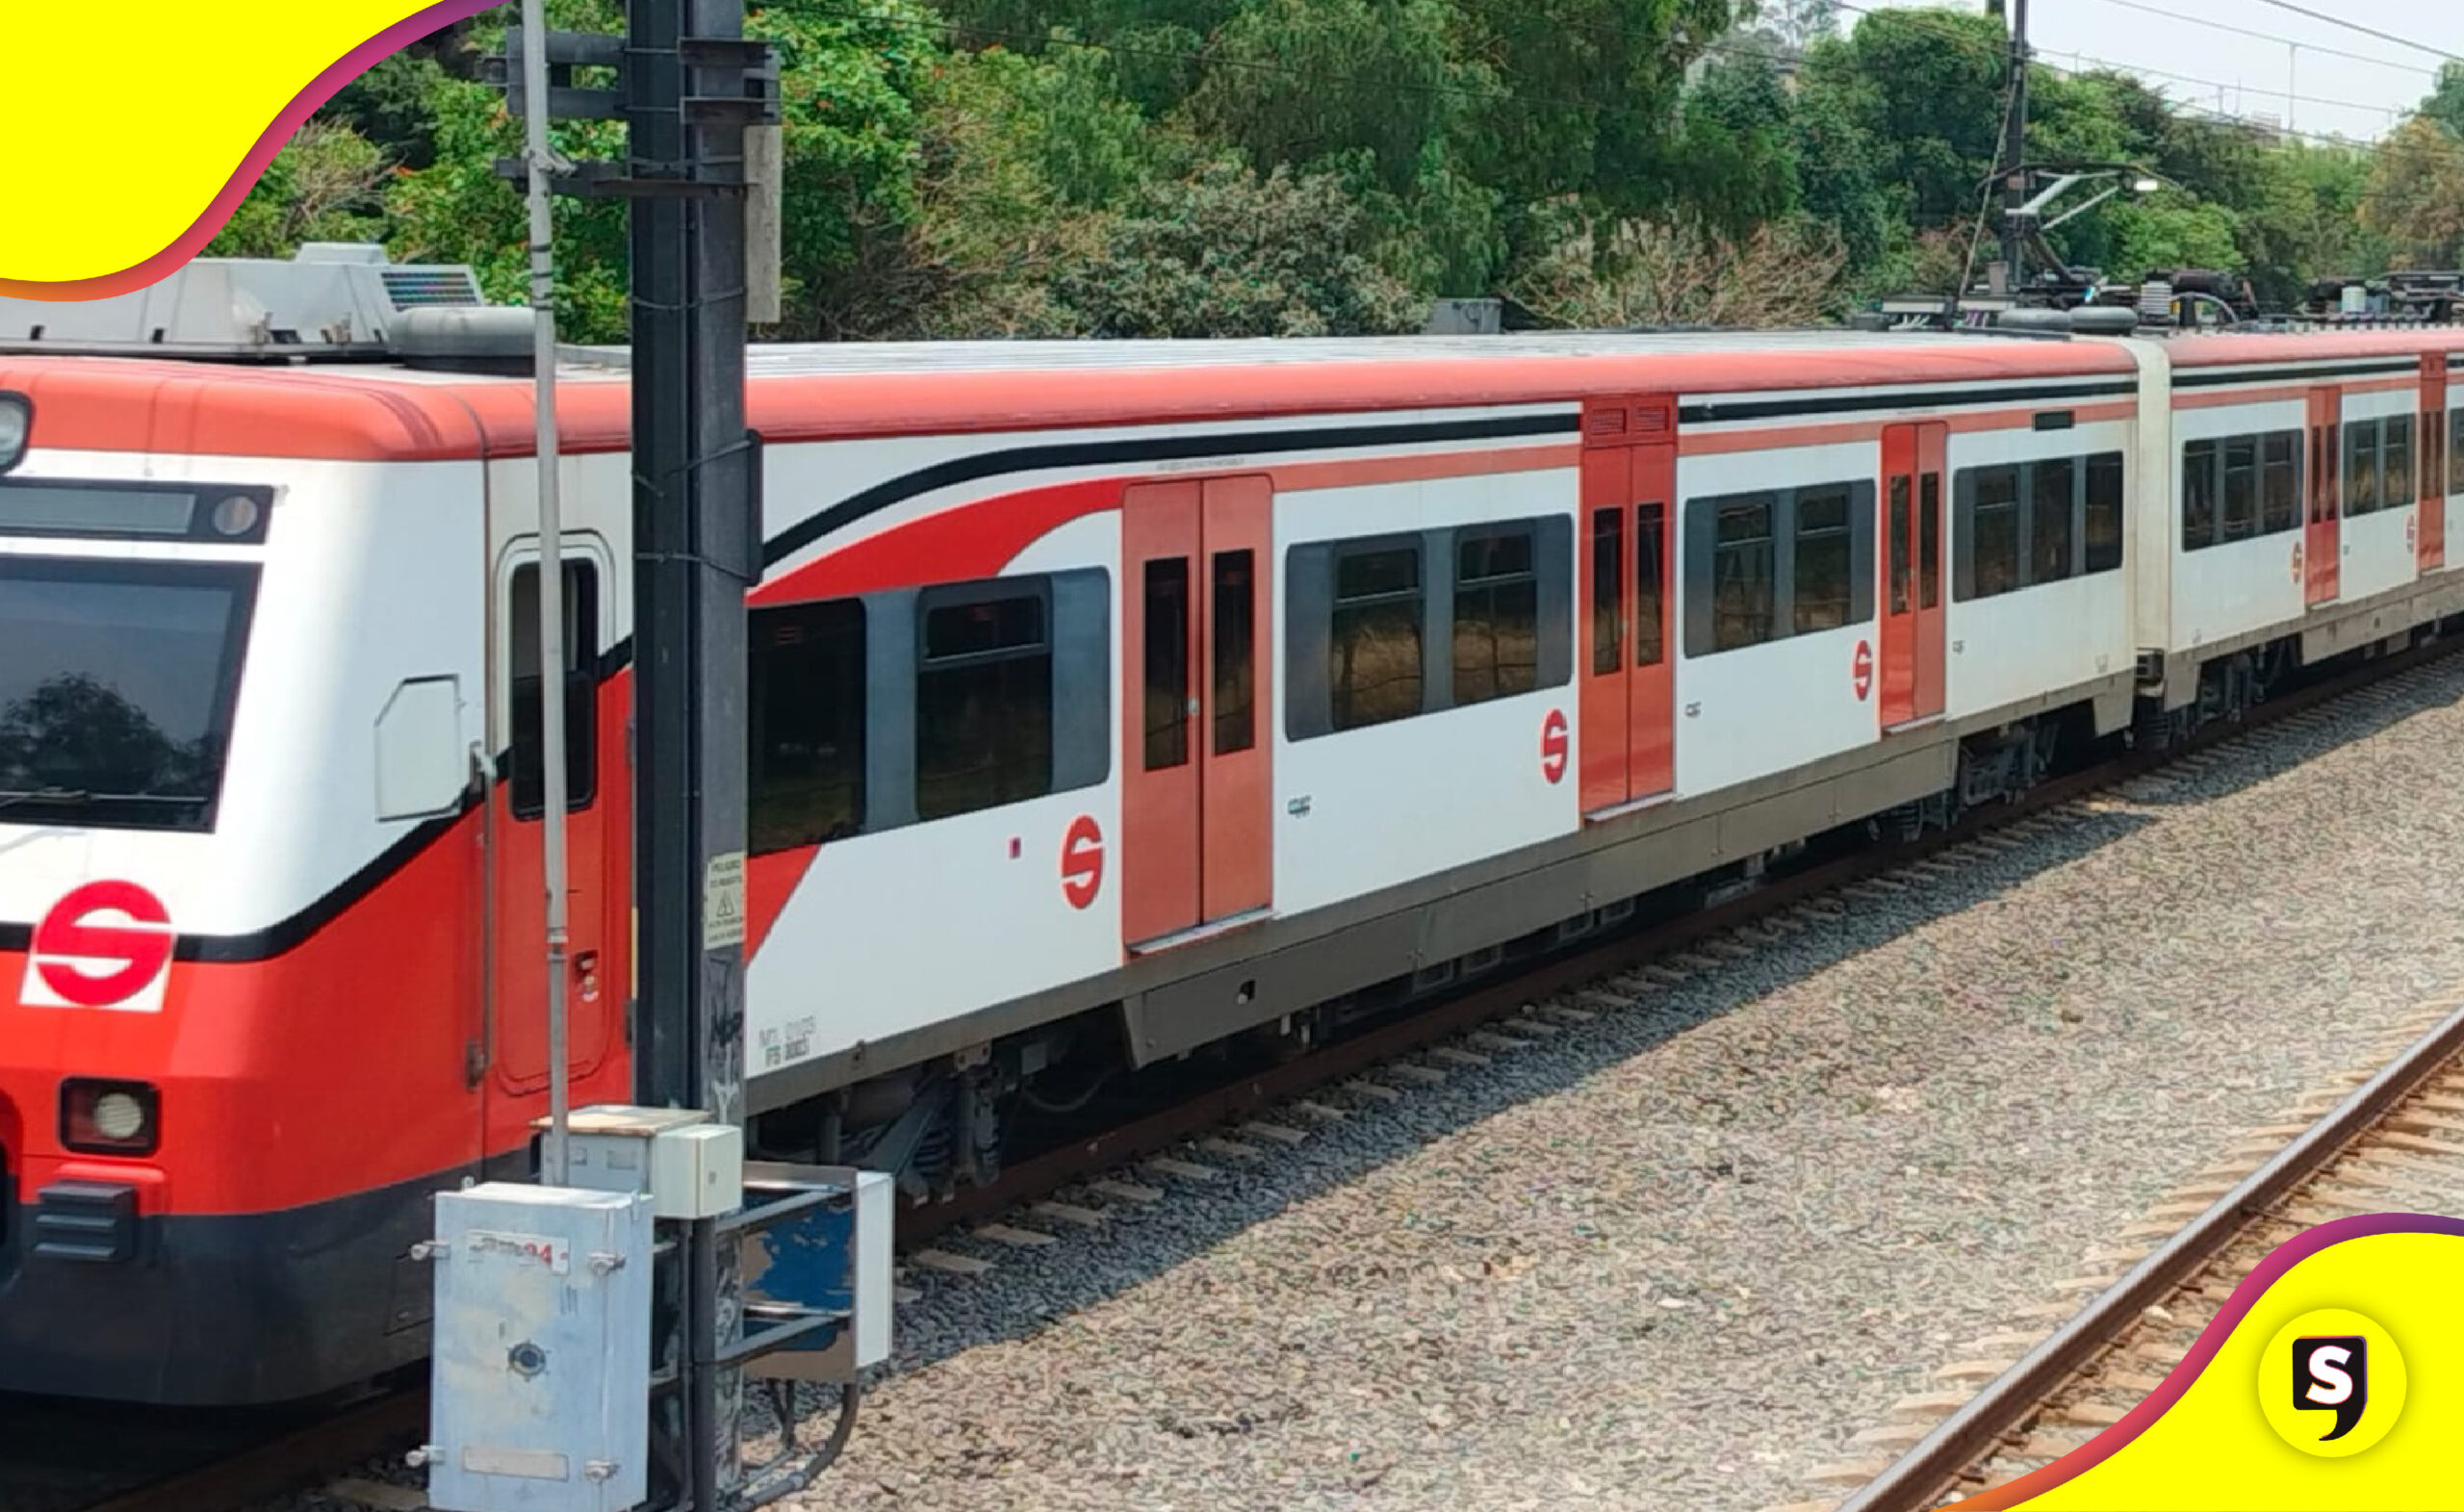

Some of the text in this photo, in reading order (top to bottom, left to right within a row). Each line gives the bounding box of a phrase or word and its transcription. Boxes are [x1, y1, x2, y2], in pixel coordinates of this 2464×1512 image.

[1541, 709, 1567, 783] S
[1062, 815, 1102, 910] S
[36, 880, 171, 1007] S
